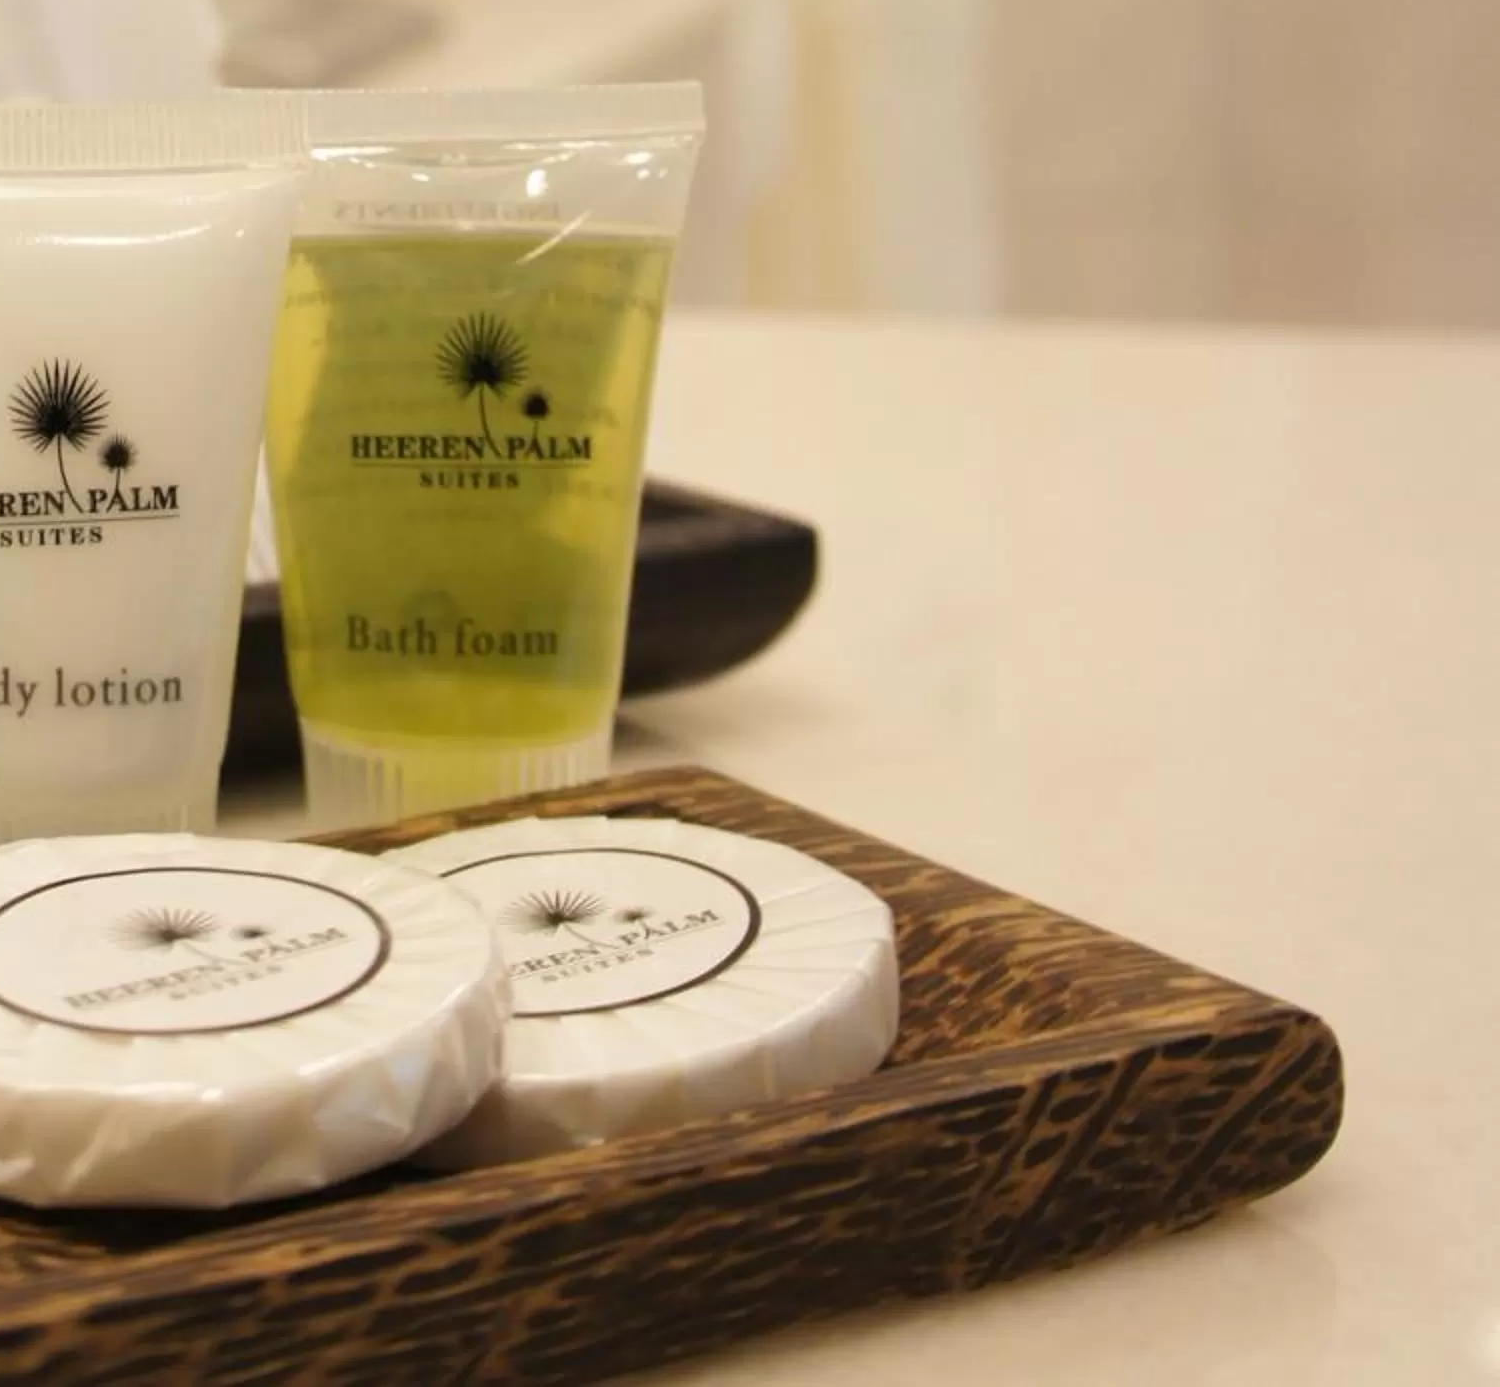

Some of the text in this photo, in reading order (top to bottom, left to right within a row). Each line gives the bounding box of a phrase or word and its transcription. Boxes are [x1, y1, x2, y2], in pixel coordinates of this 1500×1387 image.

[351, 434, 592, 460] HEEREN PALM
[420, 471, 519, 489] SUITES
[88, 485, 179, 513] PALM
[0, 526, 104, 548] SUITES
[346, 613, 558, 656] Bath foam
[55, 667, 183, 707] lotion
[619, 909, 720, 946] PALM
[240, 926, 348, 963] PALM
